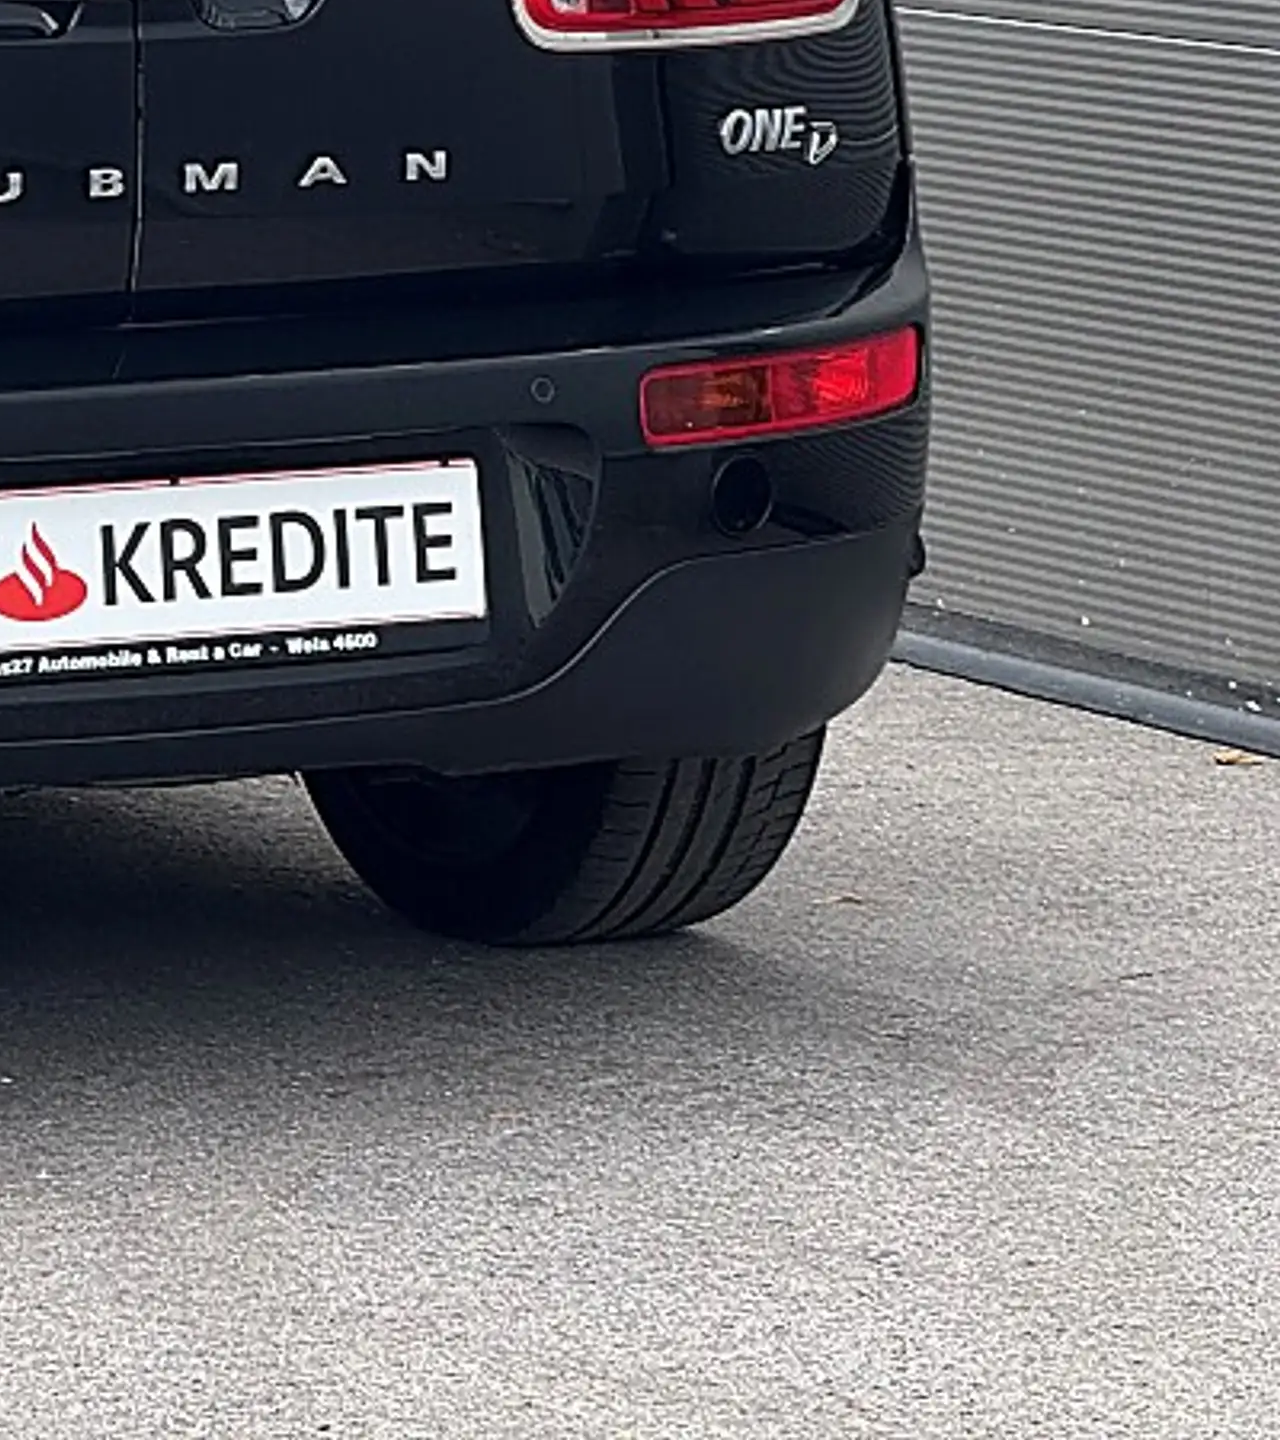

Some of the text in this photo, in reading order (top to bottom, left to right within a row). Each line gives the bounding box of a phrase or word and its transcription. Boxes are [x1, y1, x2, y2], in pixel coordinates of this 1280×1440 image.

[100, 502, 457, 605] KREDITE
[39, 649, 142, 674] Automobile
[166, 644, 209, 663] Rent
[229, 642, 262, 659] Car
